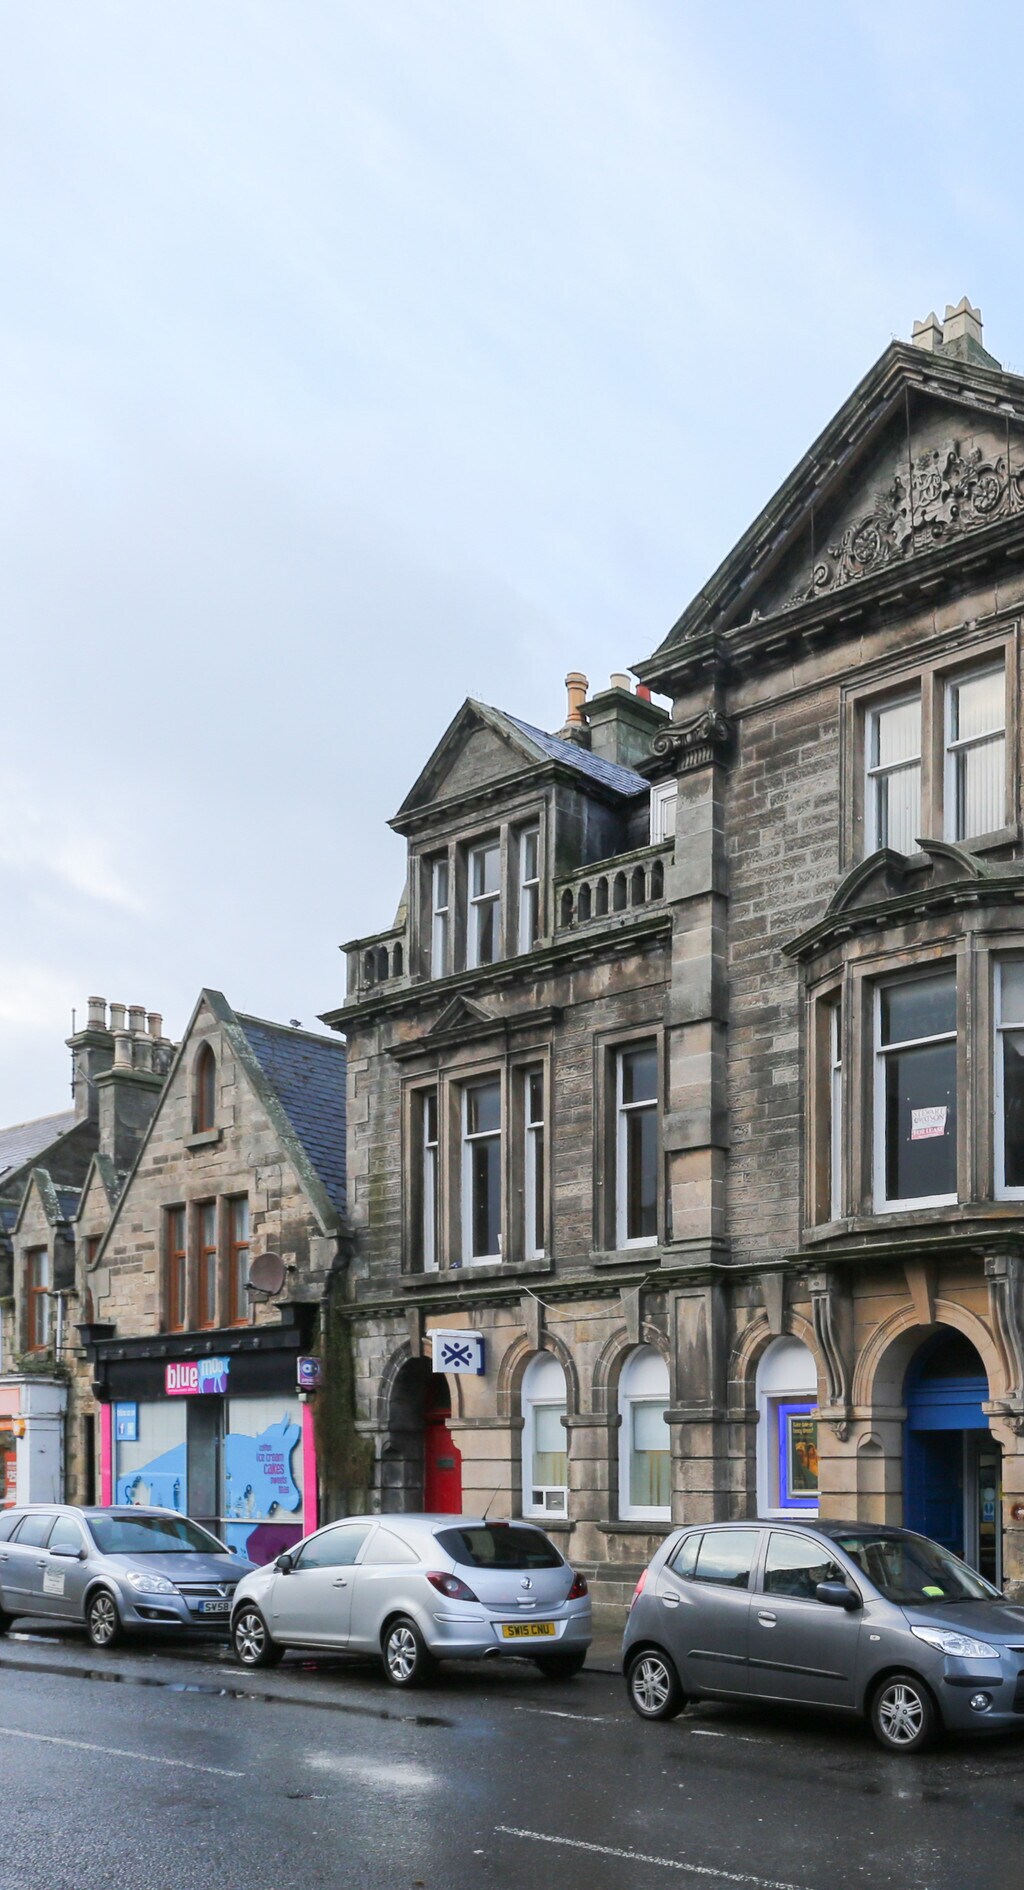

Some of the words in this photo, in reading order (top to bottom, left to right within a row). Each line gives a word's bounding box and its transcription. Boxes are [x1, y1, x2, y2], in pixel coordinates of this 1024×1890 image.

[167, 1363, 198, 1389] blue
[264, 1463, 285, 1475] cakes
[507, 1625, 529, 1636] SW15
[530, 1624, 550, 1635] CNU
